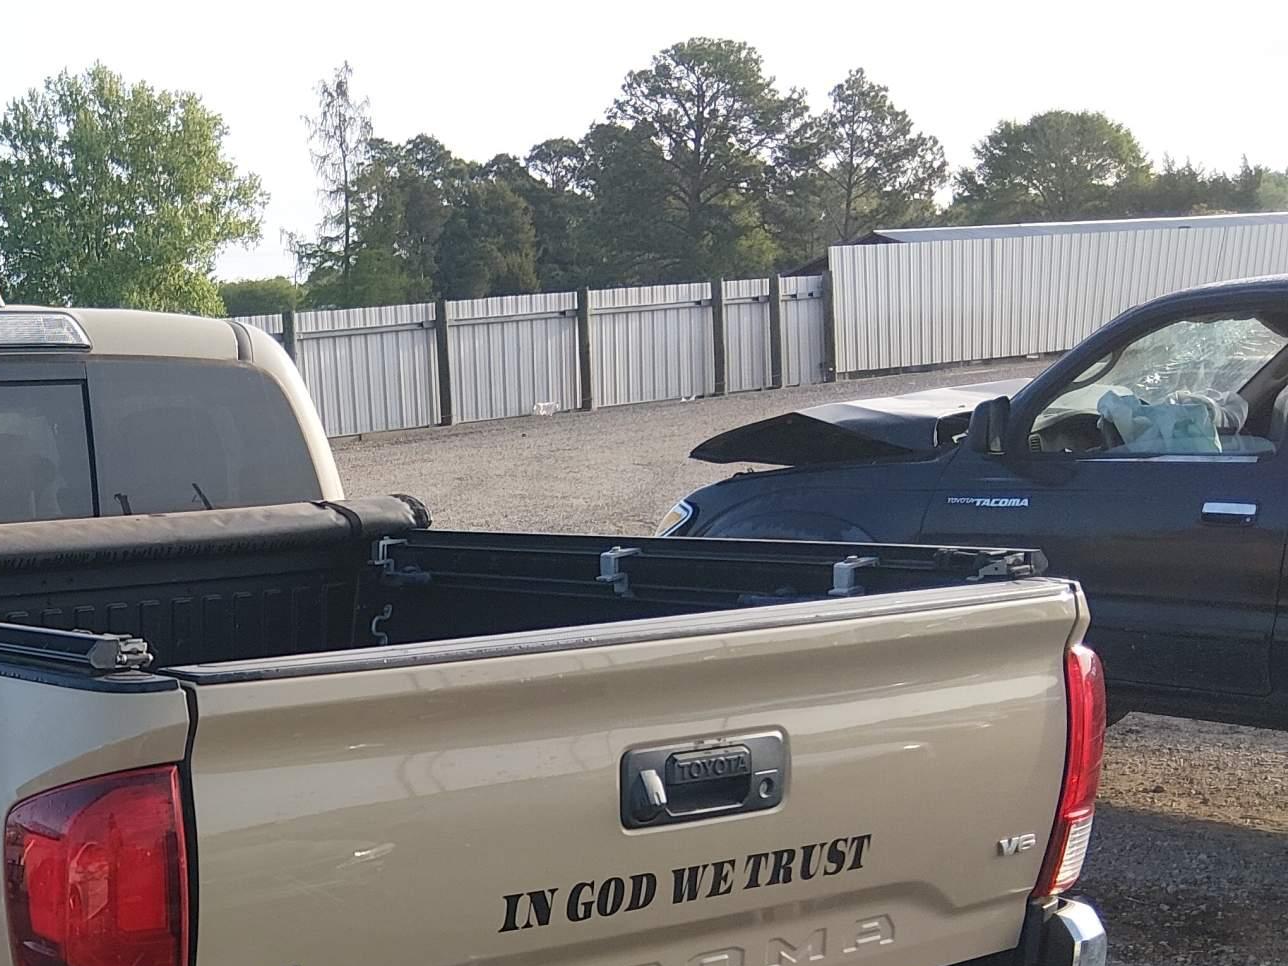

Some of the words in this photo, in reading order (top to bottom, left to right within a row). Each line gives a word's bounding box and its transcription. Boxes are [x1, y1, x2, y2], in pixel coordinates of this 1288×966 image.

[973, 498, 1029, 507] TACOMA
[677, 755, 748, 780] TOYOTA
[998, 833, 1037, 857] V6
[498, 887, 559, 933] IN
[566, 872, 658, 923] GOD
[671, 858, 737, 905] WE
[743, 833, 873, 890] TRUST
